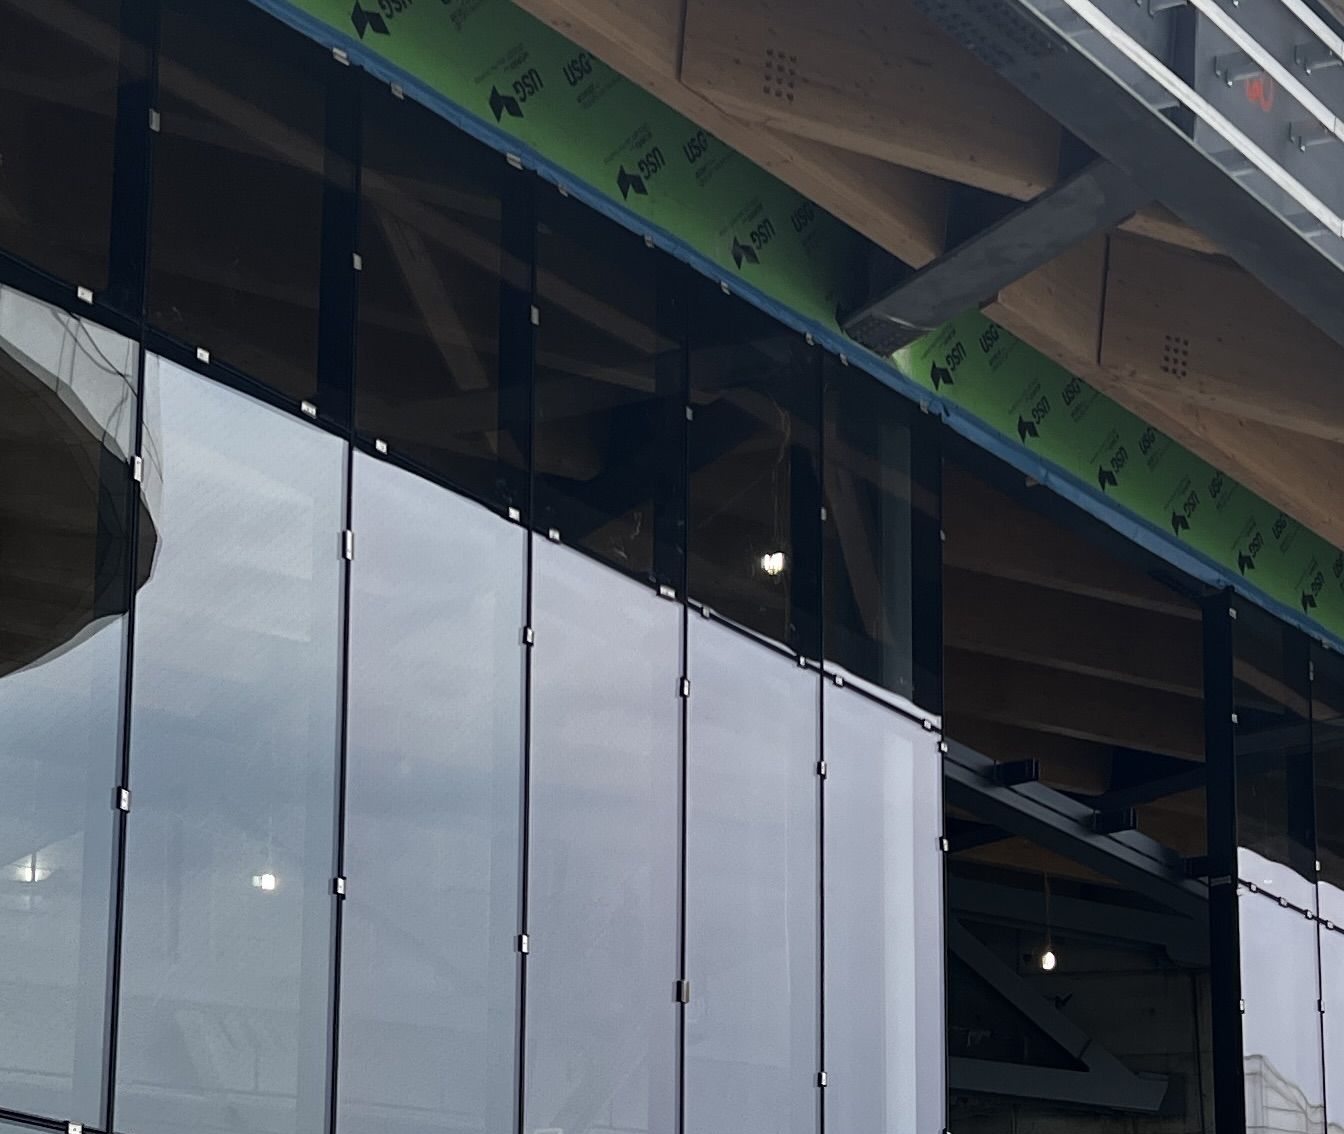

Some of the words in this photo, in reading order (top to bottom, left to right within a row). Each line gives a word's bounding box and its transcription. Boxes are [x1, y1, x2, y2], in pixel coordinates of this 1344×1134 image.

[512, 68, 544, 103] USG
[563, 52, 593, 87] USG
[638, 146, 666, 181] USG
[683, 130, 708, 164] USG
[750, 217, 776, 250] USG
[979, 324, 999, 354] USG
[945, 341, 967, 372] USG
[1061, 377, 1081, 406] USG
[1031, 395, 1051, 425] USG
